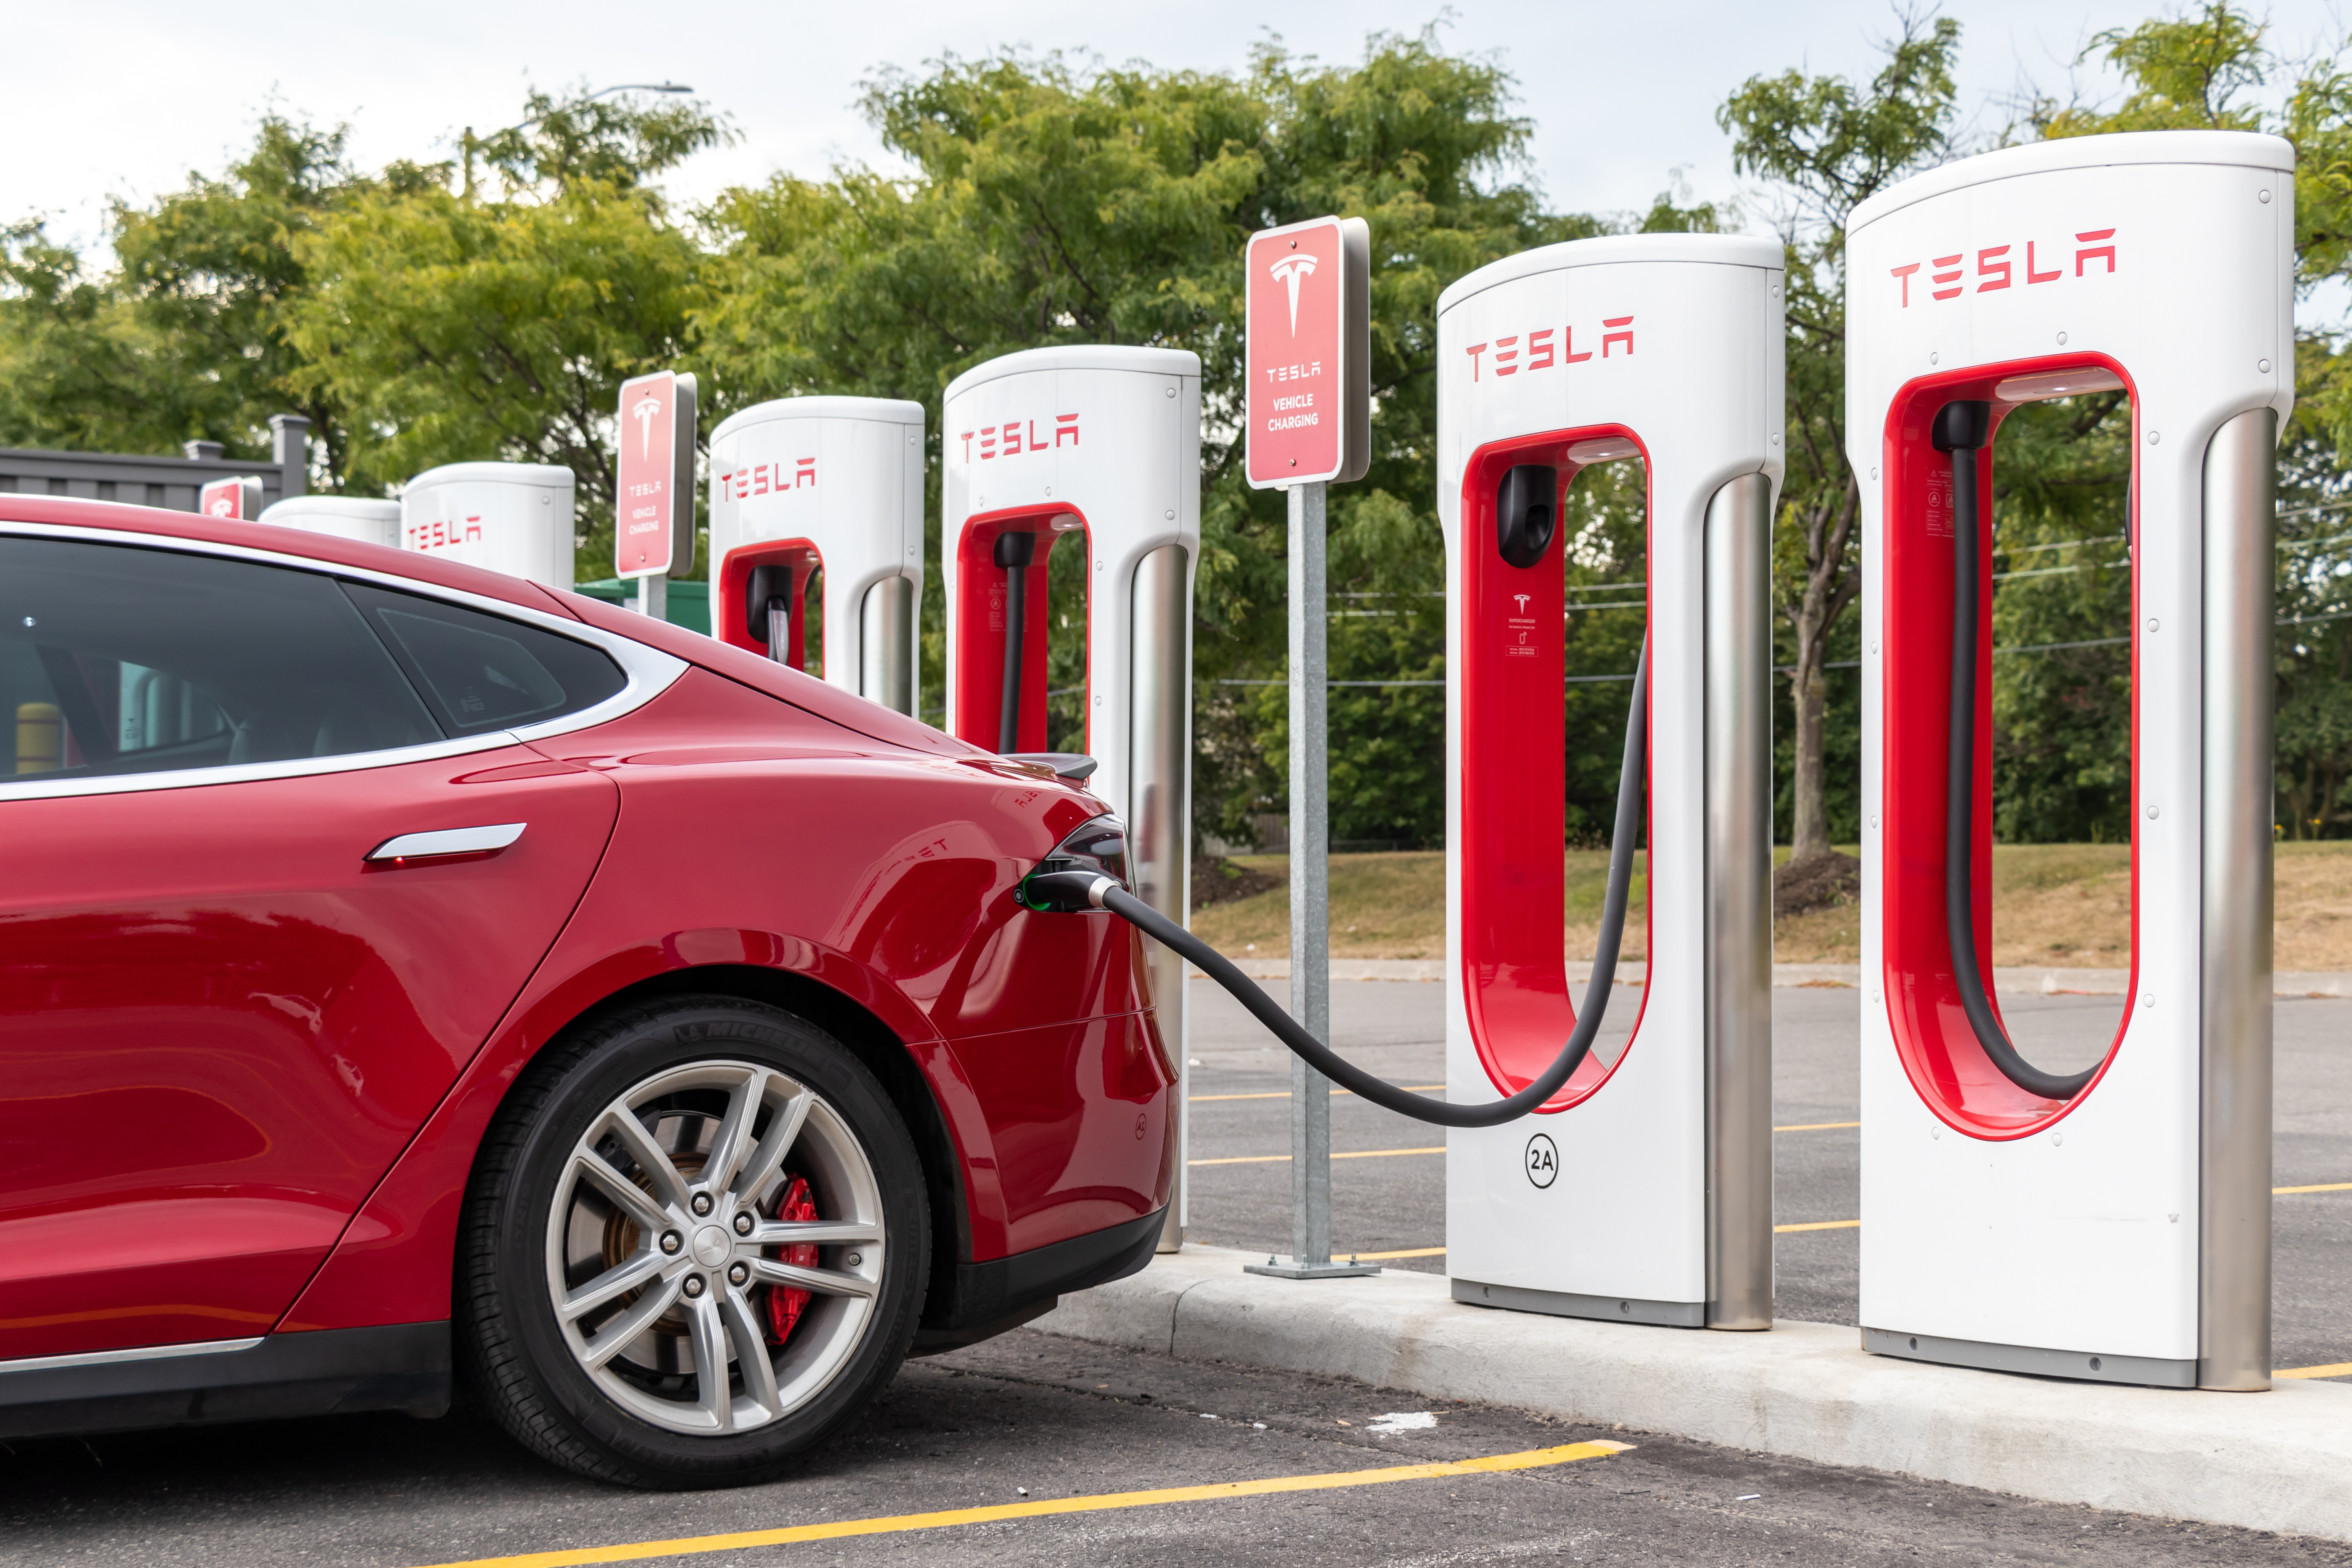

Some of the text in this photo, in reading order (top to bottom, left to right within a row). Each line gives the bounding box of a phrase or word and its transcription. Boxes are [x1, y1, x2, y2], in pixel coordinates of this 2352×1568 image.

[1891, 228, 2116, 308] TESLA
[1466, 316, 1634, 382] TESLA
[1267, 361, 1321, 383] TESLA
[1273, 393, 1313, 411] VEHICLE
[1268, 412, 1318, 432] CHARGING
[961, 413, 1079, 463] TESLA
[629, 481, 661, 497] TESLA
[721, 457, 815, 502] TESLA
[633, 505, 657, 519] VEHICLE
[409, 516, 481, 552] TESLA
[629, 520, 659, 535] CHARGING
[706, 1022, 826, 1069] MICHELIN
[1531, 1149, 1553, 1171] 2A
